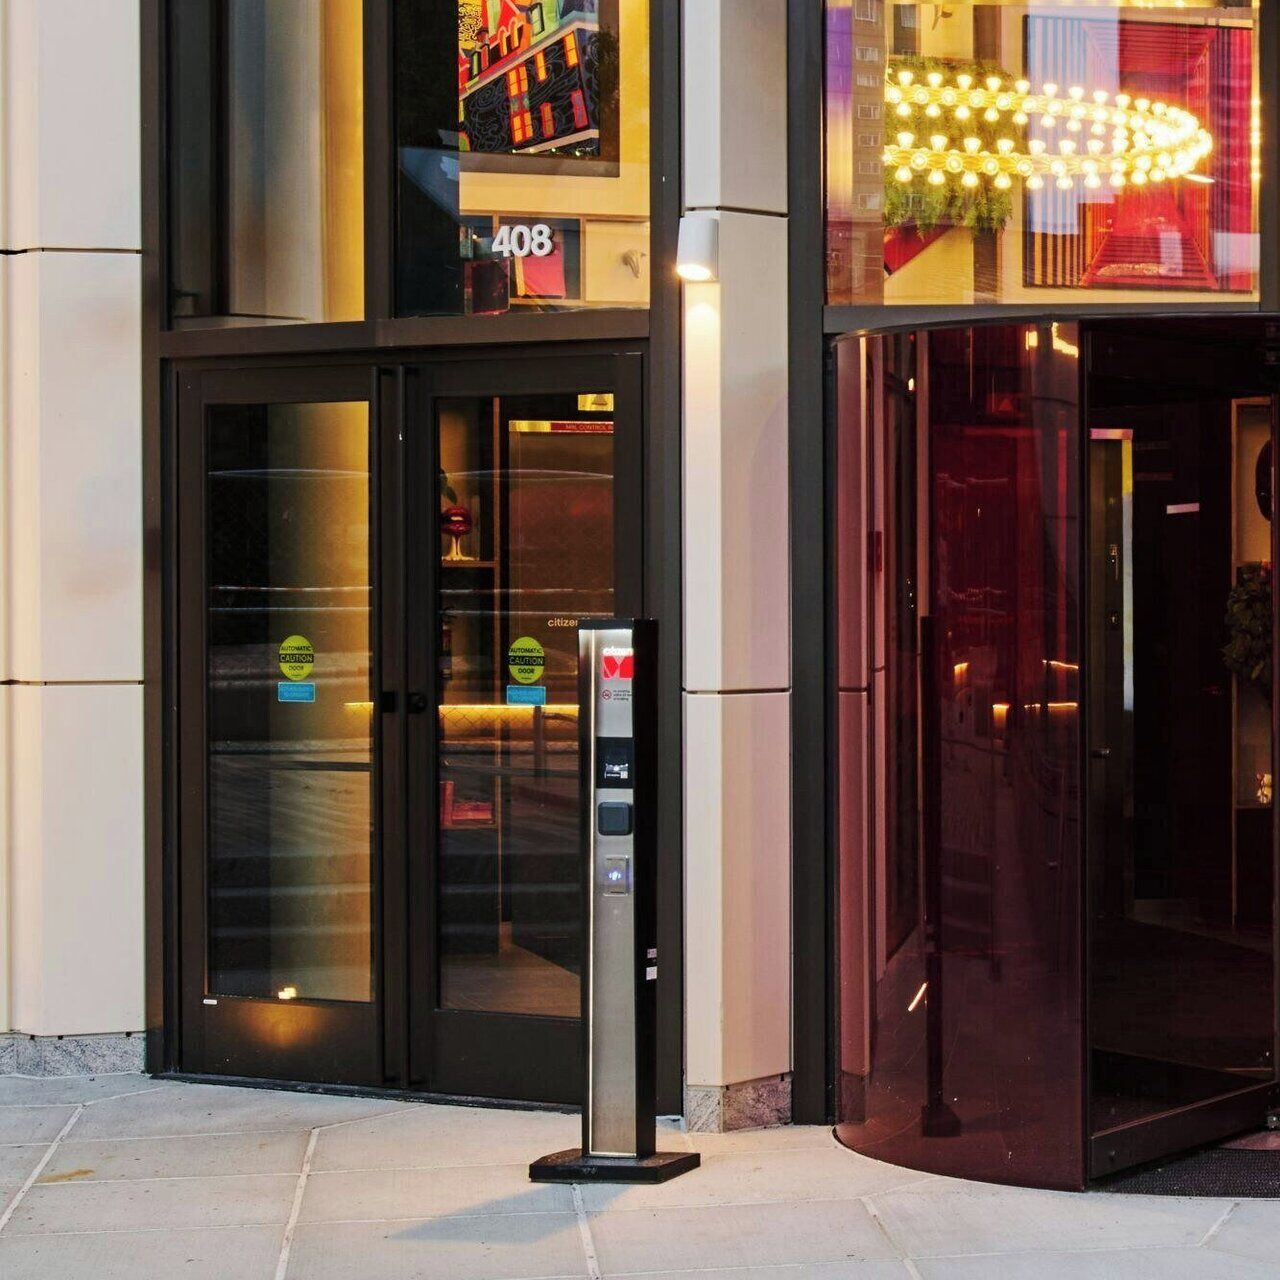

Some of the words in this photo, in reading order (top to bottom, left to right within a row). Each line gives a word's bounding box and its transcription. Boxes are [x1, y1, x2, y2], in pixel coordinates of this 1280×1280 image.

[491, 223, 553, 258] 408
[280, 654, 313, 662] CAUTION
[510, 656, 544, 665] CAUTION
